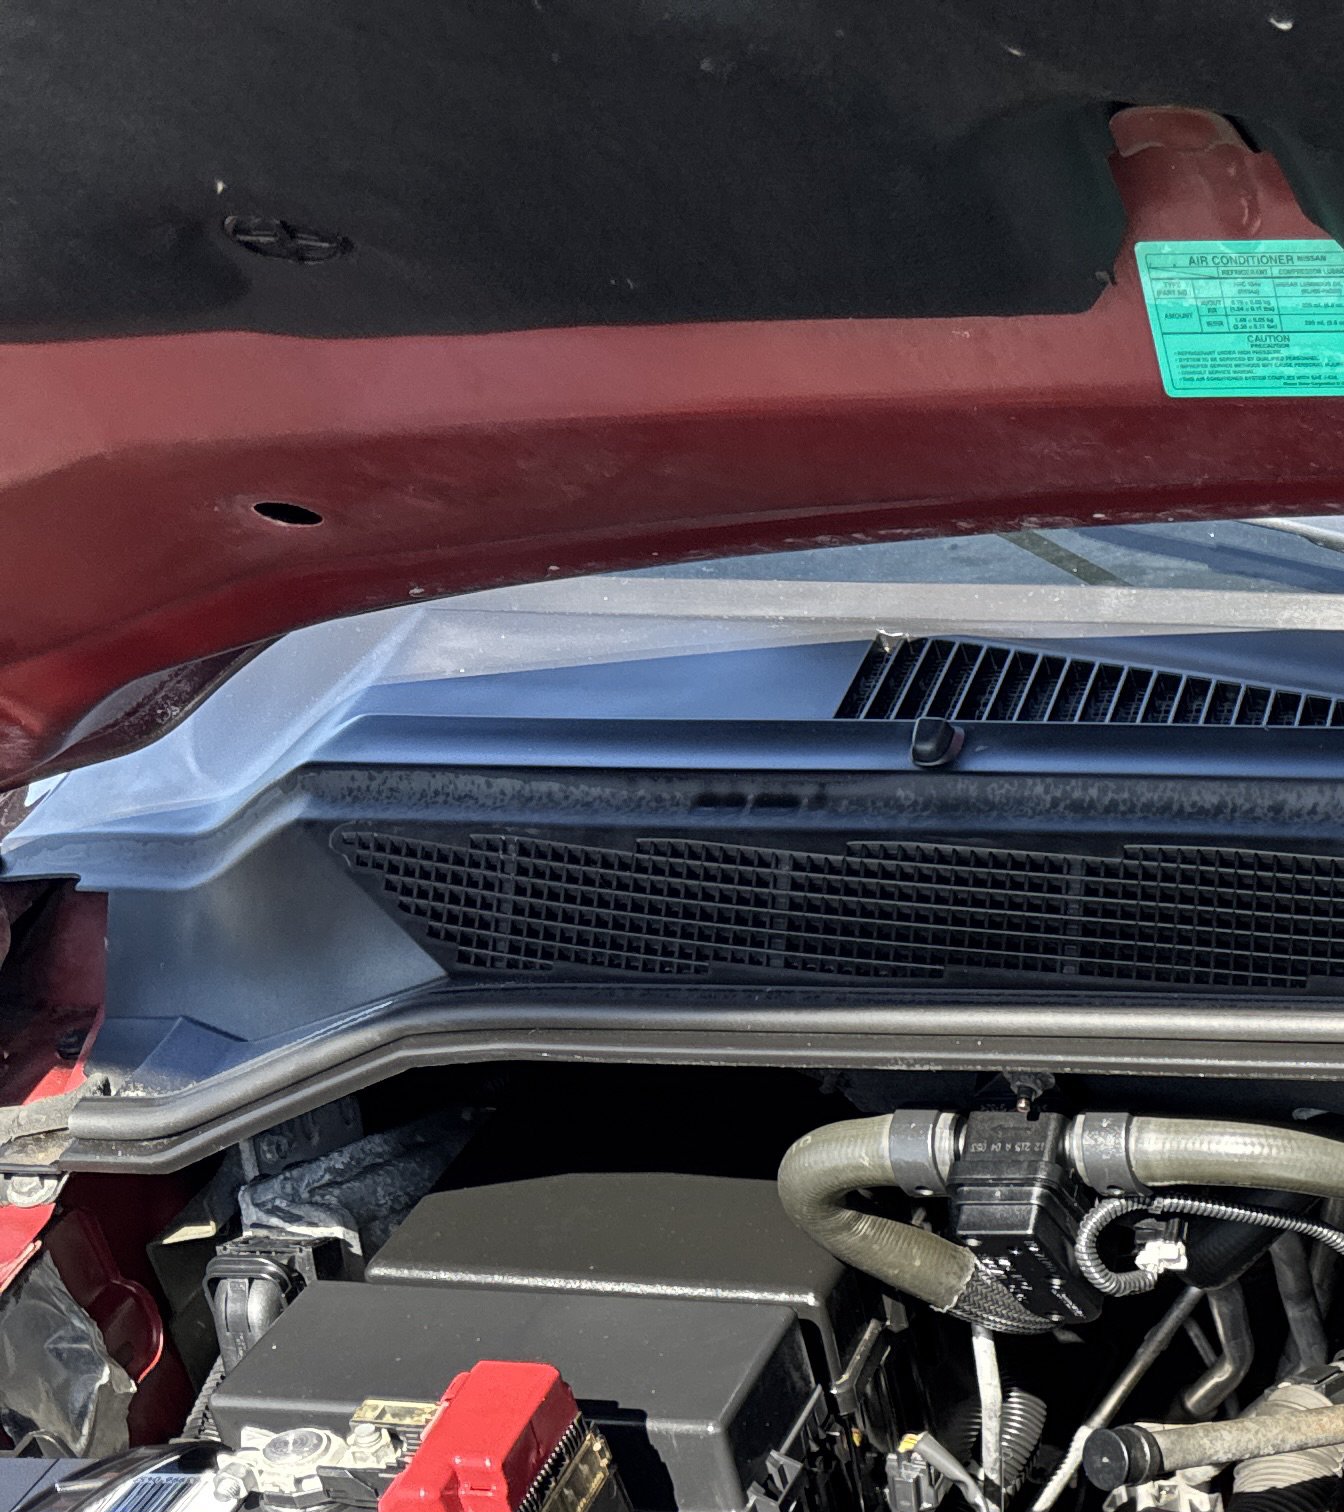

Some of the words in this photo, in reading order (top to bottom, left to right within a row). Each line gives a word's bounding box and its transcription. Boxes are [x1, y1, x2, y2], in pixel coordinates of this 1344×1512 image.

[1189, 256, 1208, 266] AIR
[1212, 255, 1294, 265] CONDITIONER
[1247, 335, 1290, 343] CAUTION
